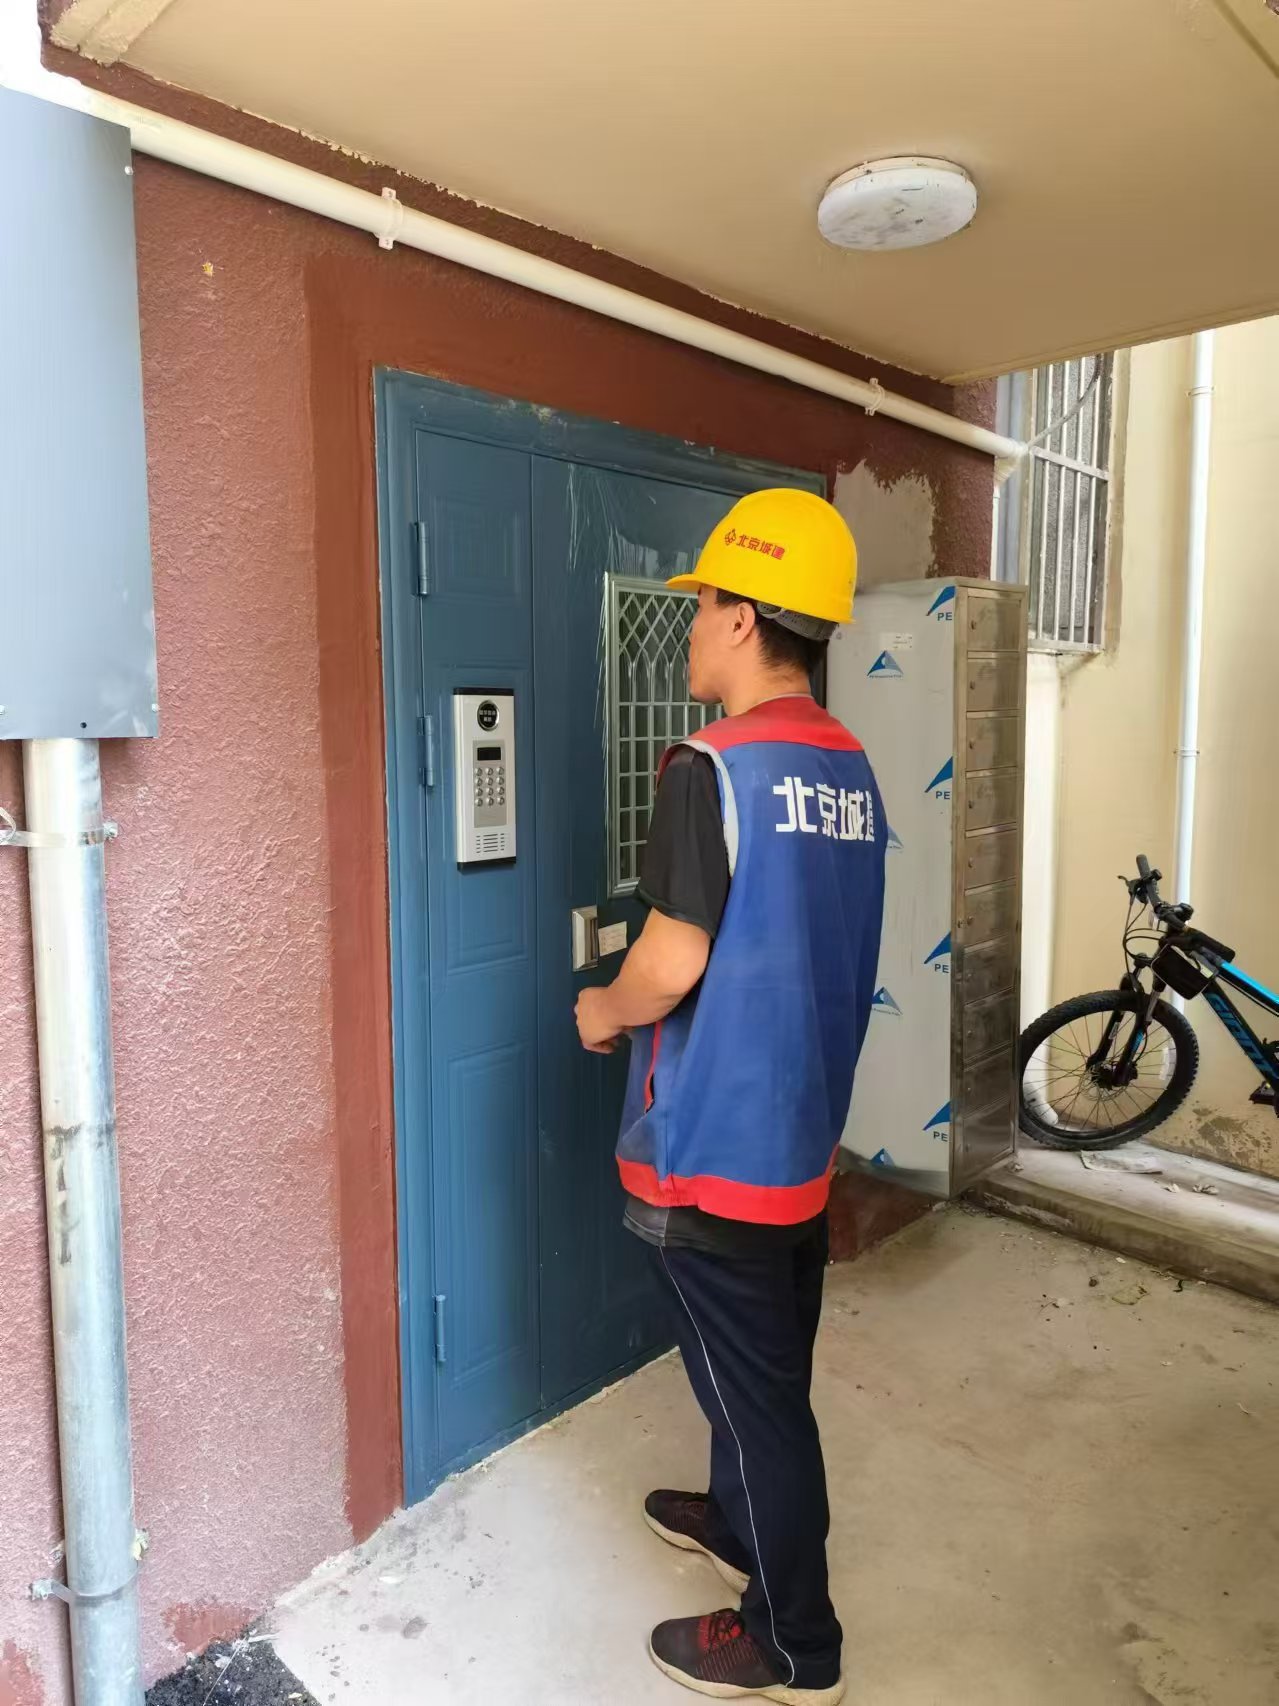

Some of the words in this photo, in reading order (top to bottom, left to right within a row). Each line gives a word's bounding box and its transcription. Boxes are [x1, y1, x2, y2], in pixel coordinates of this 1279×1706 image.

[736, 534, 786, 560] 北京城建
[937, 611, 953, 621] PE
[935, 790, 951, 800] PE
[934, 963, 950, 974] PE
[933, 1131, 948, 1142] PE
